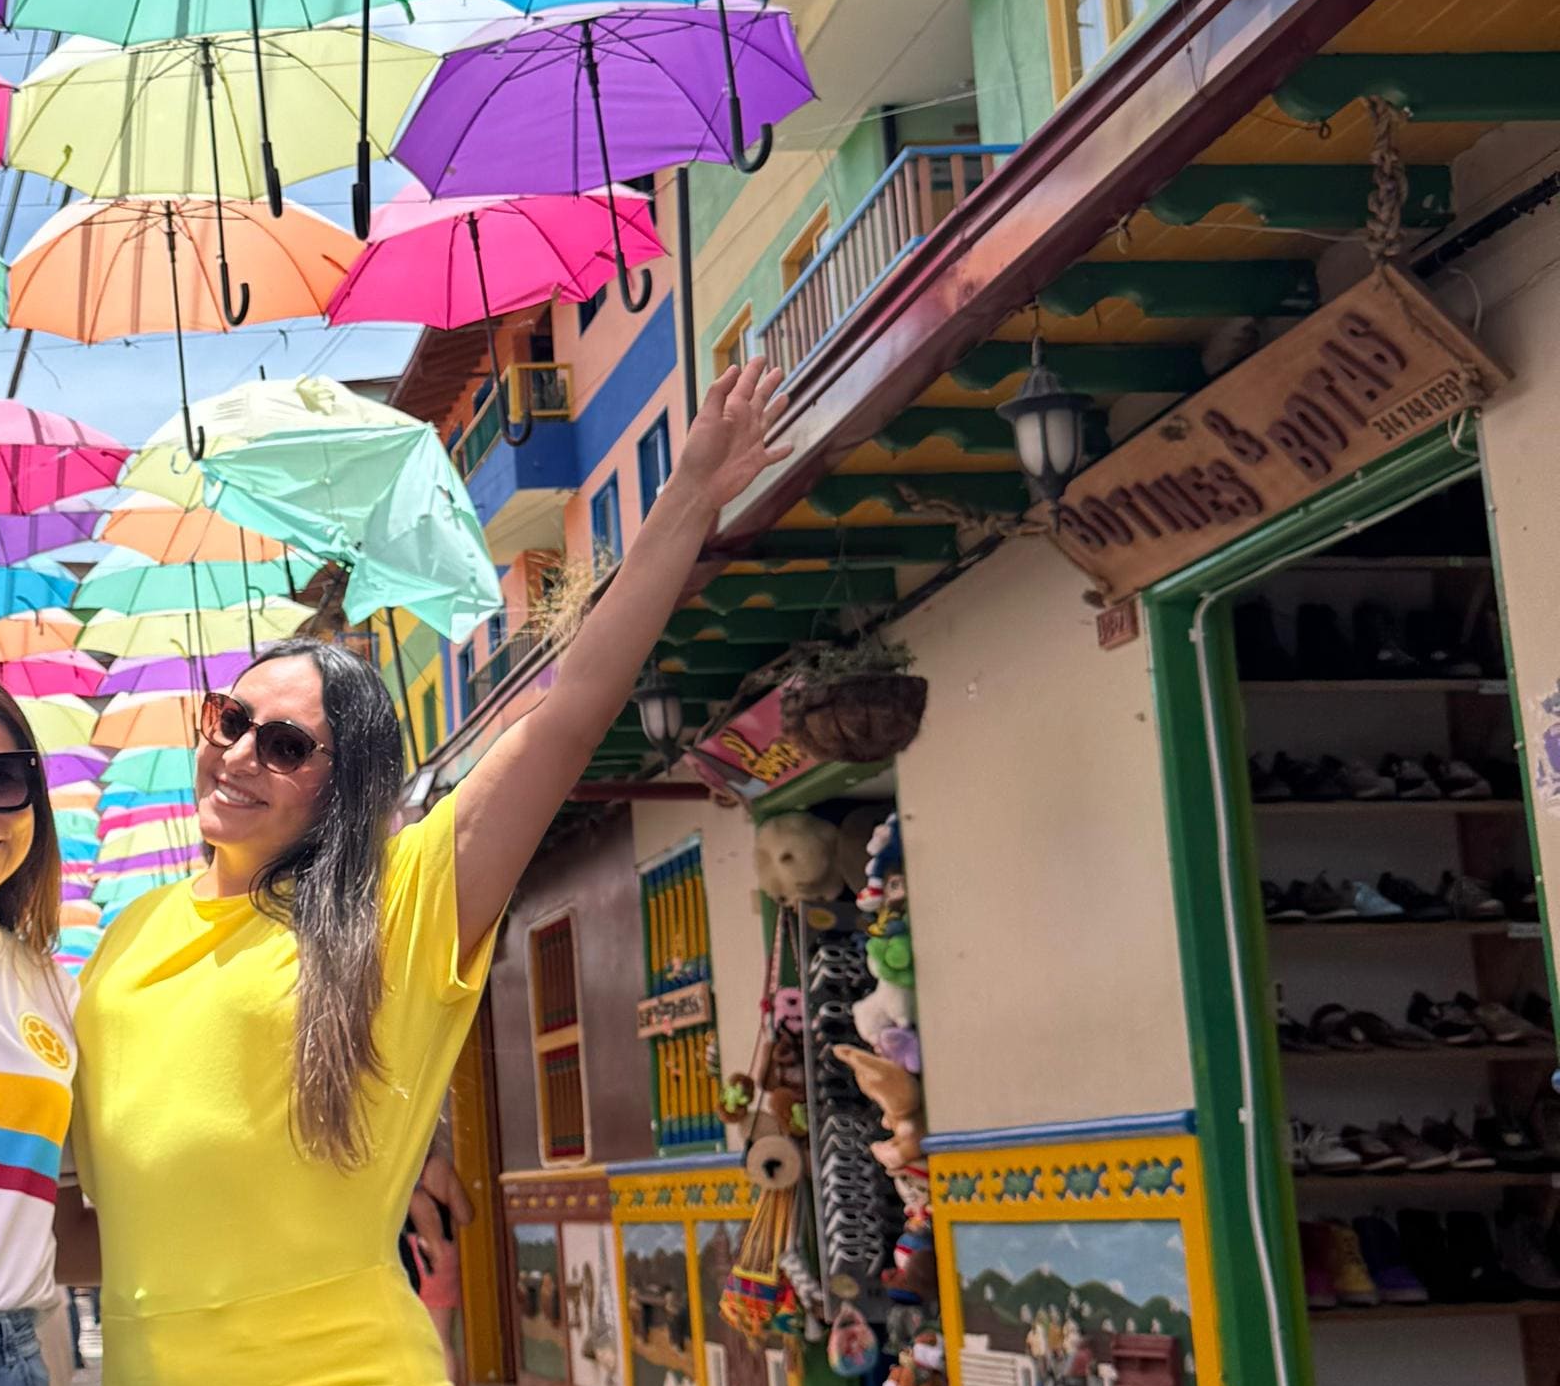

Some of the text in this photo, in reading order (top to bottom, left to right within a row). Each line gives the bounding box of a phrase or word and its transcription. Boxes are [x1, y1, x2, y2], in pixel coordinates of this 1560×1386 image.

[1057, 312, 1408, 551] BOTINES & BOTAS
[1371, 376, 1465, 441] 314 748 0739
